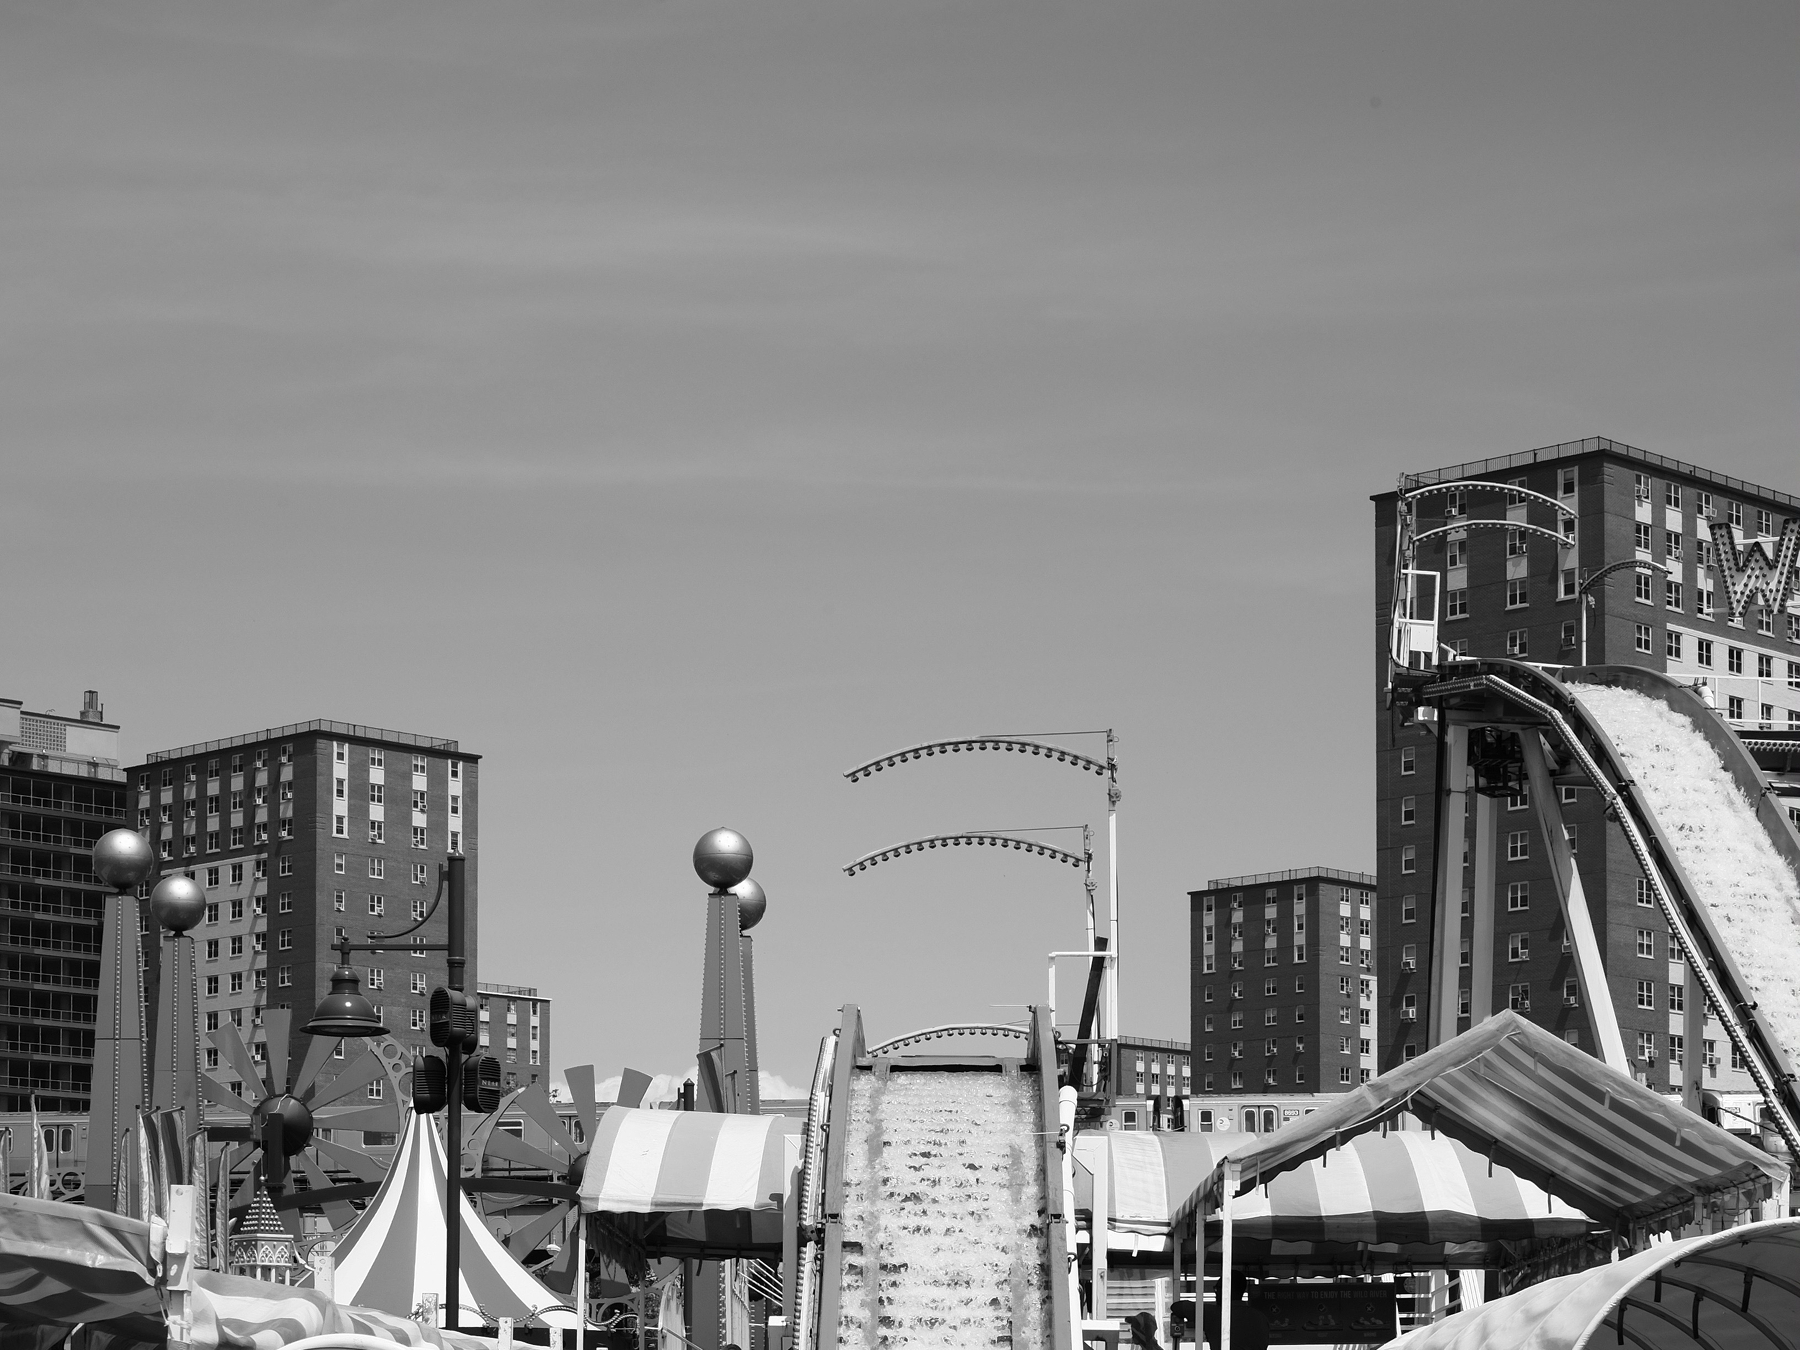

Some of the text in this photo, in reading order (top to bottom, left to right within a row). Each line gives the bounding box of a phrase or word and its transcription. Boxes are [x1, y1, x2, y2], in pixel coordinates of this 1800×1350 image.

[1264, 1291, 1276, 1300] THE
[1311, 1291, 1319, 1299] TO
[1320, 1290, 1338, 1299] ENJOY
[1340, 1290, 1352, 1299] THE
[1370, 1290, 1387, 1298] RIVER
